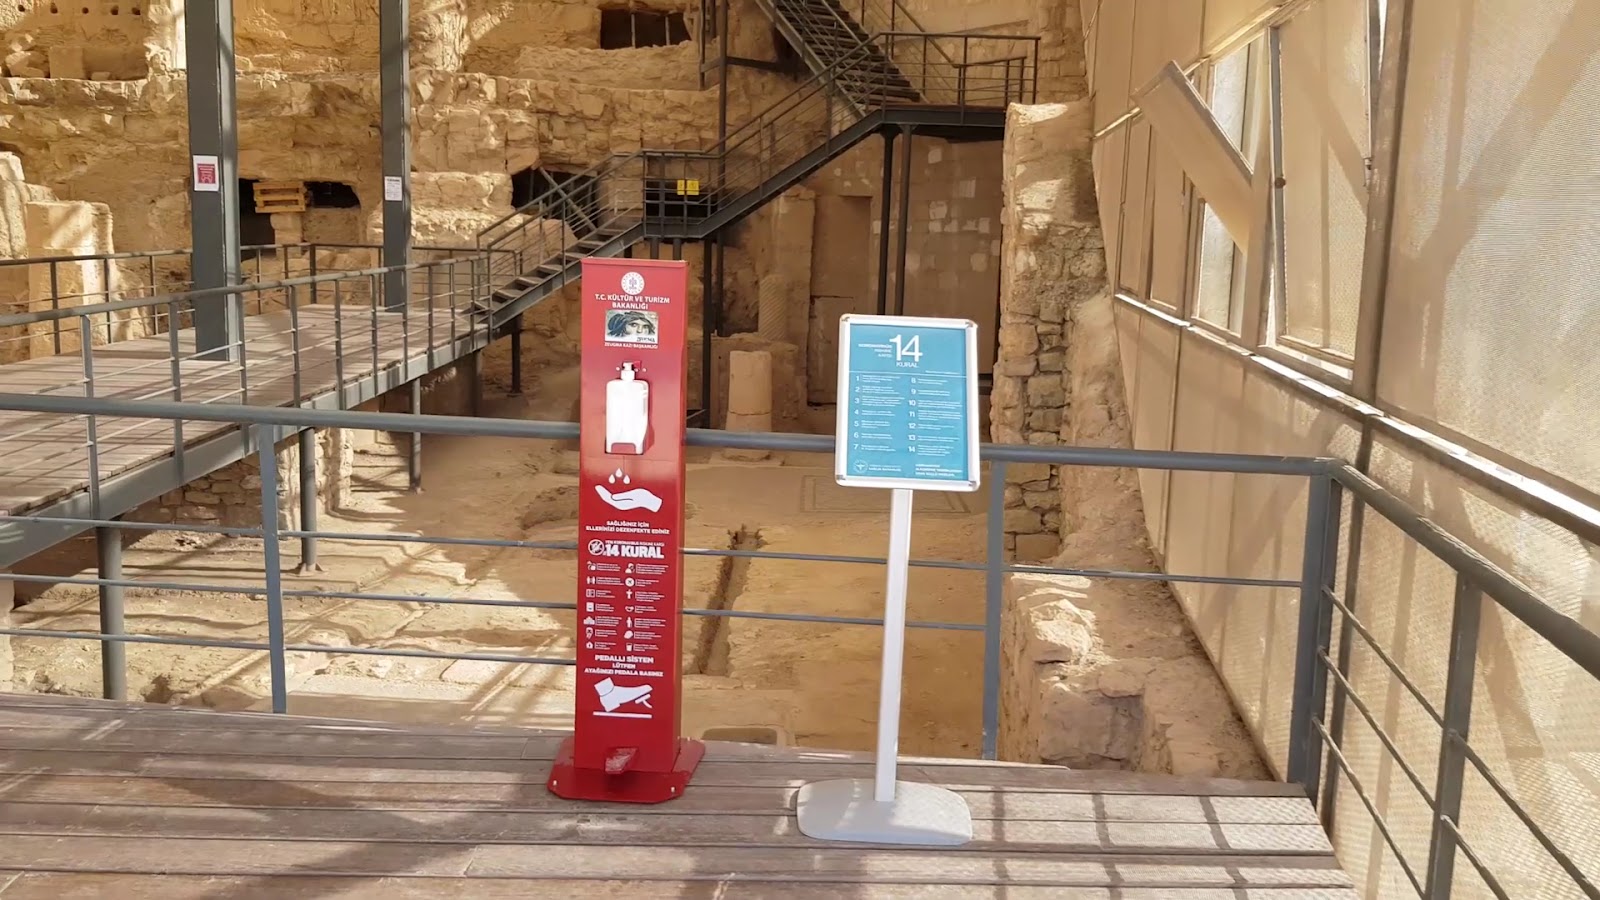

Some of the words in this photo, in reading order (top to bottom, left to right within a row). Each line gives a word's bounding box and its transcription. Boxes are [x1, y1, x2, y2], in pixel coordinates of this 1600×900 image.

[889, 334, 923, 362] 14
[605, 544, 619, 556] 14
[621, 545, 664, 559] KURAL
